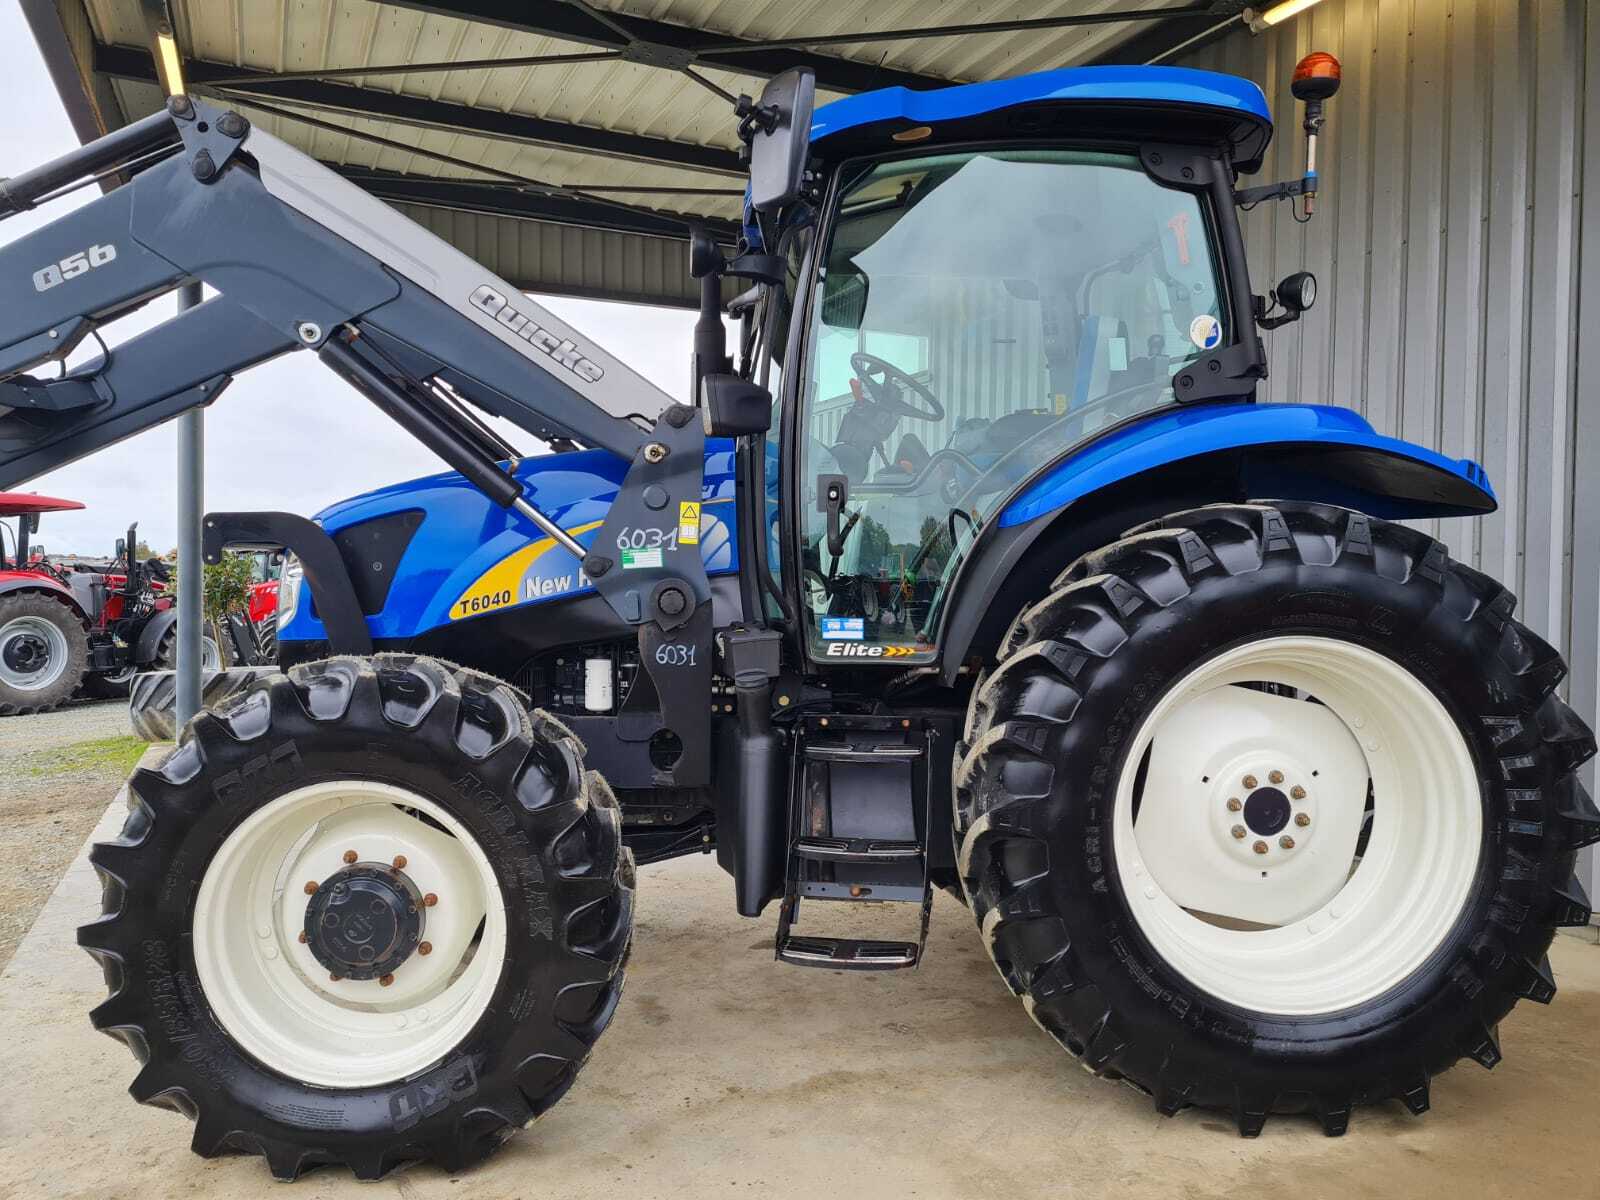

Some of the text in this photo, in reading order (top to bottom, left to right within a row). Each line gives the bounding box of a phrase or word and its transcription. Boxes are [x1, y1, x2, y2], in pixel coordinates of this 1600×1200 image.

[32, 244, 116, 292] Q56
[469, 284, 604, 383] Quicke
[616, 527, 678, 551] 6031
[526, 574, 571, 598] New
[460, 590, 511, 614] T6040
[655, 645, 697, 666] 6031
[827, 642, 884, 656] Elite
